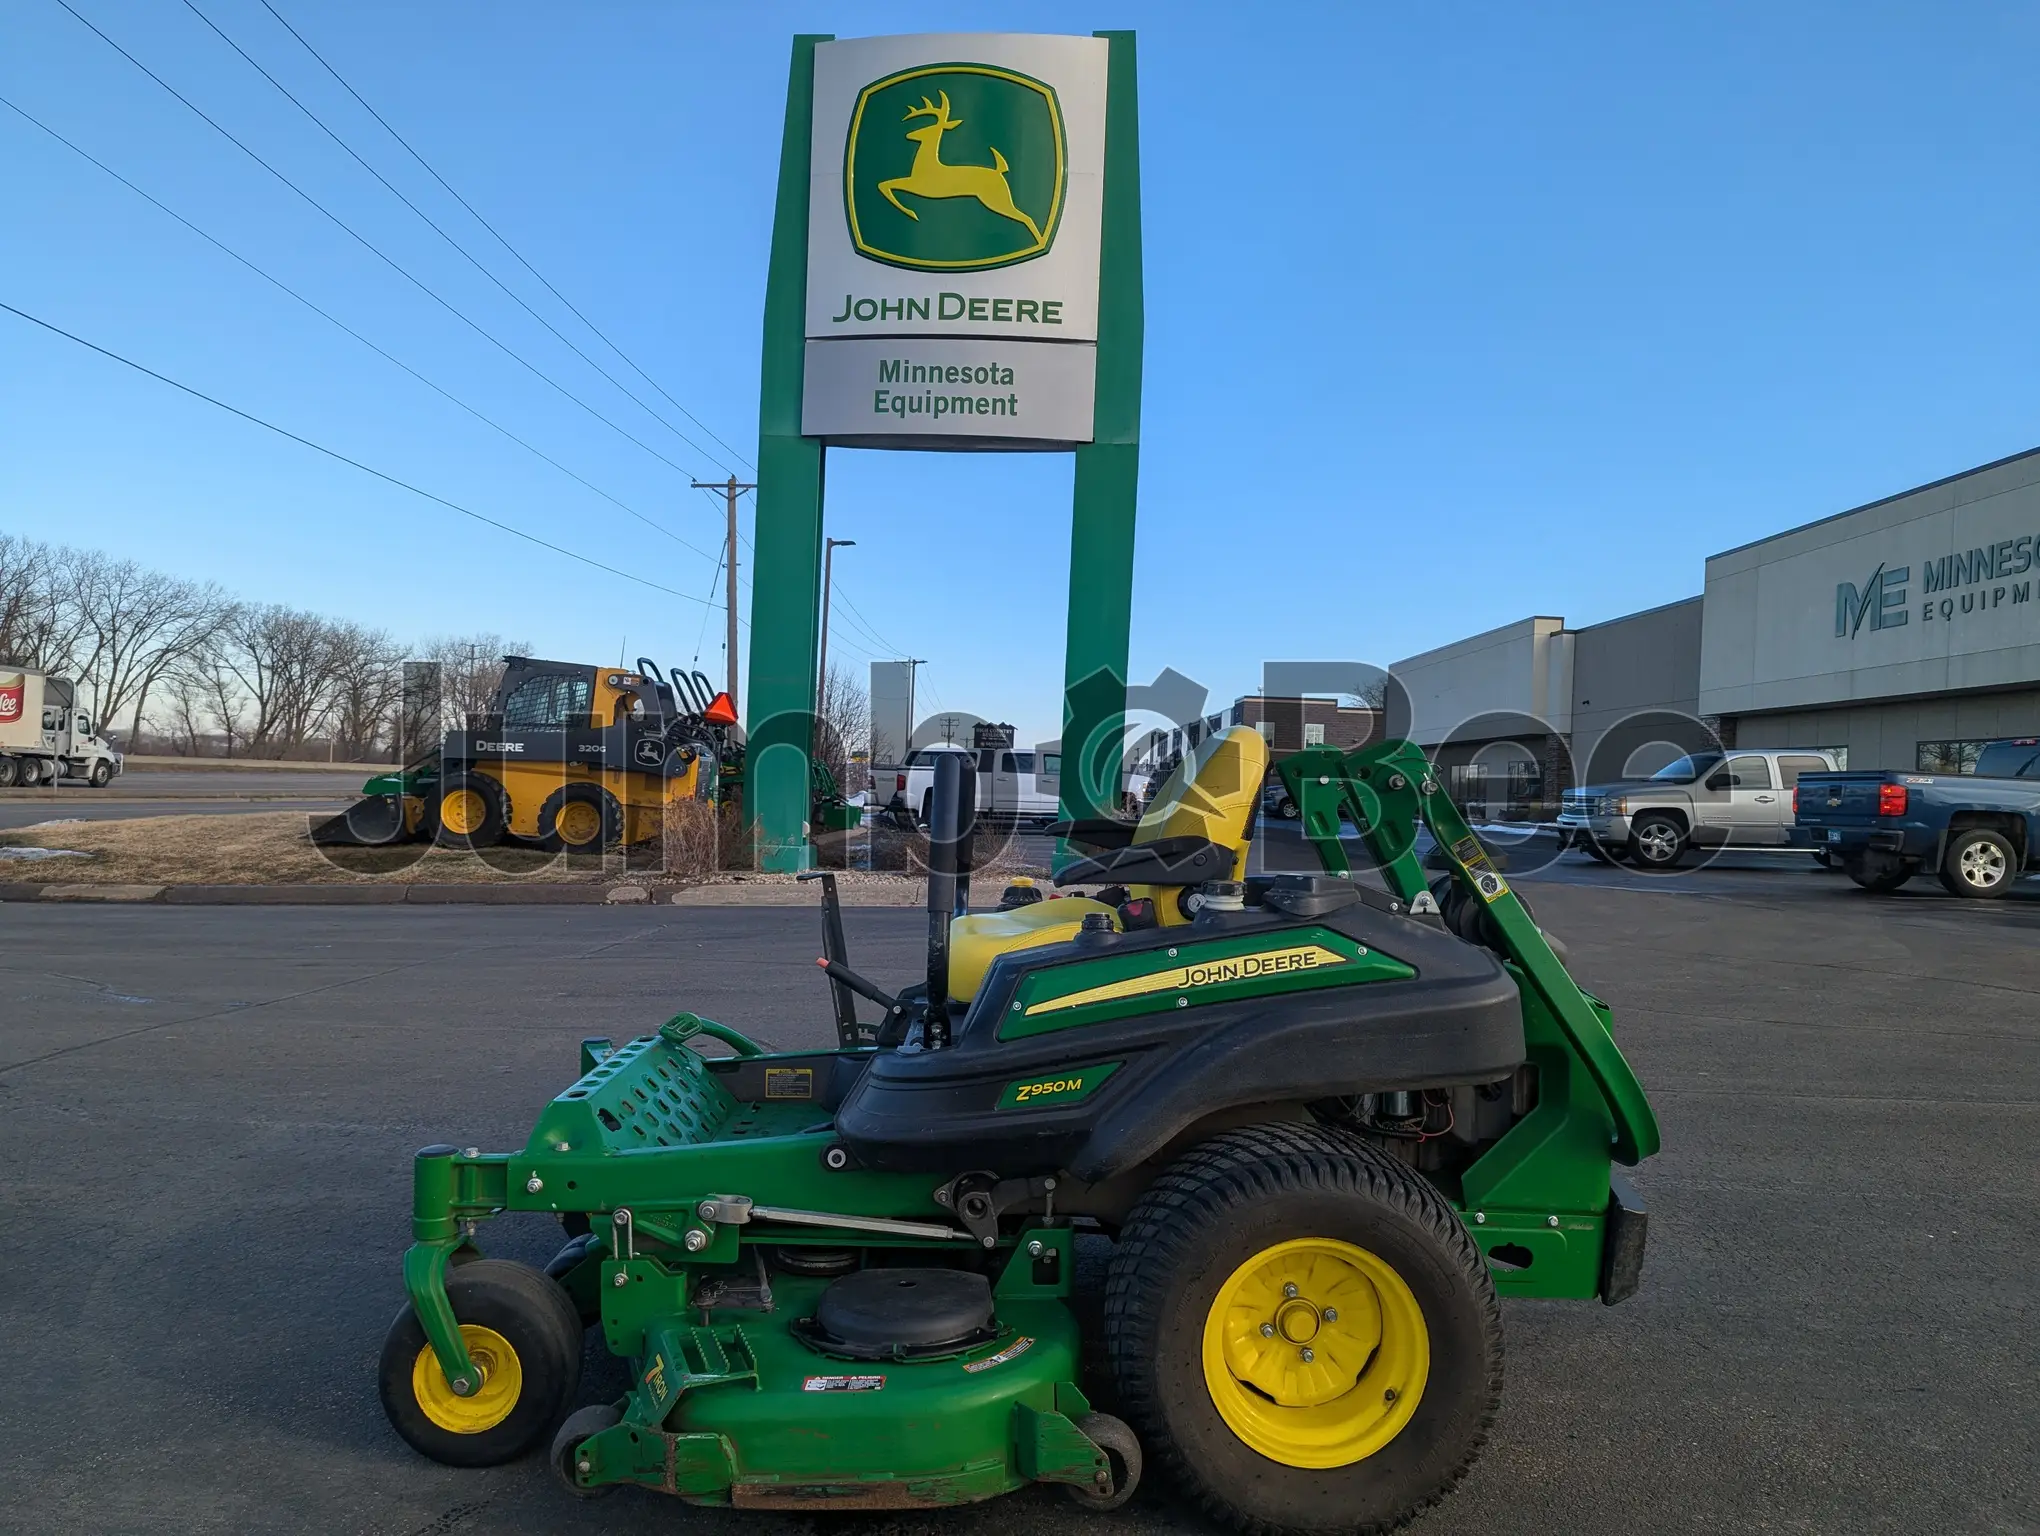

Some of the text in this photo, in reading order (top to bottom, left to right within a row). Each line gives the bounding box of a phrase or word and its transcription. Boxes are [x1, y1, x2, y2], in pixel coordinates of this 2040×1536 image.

[832, 292, 1064, 325] JOHN DEERE
[878, 359, 1014, 386] Minnesota
[873, 390, 1018, 419] Equipment
[1835, 562, 1910, 640] ME
[1922, 579, 2040, 622] EQUIPM
[475, 740, 607, 753] DEERE 320G
[1177, 951, 1318, 988] JOHN DEERE
[1015, 1078, 1083, 1102] Z950M
